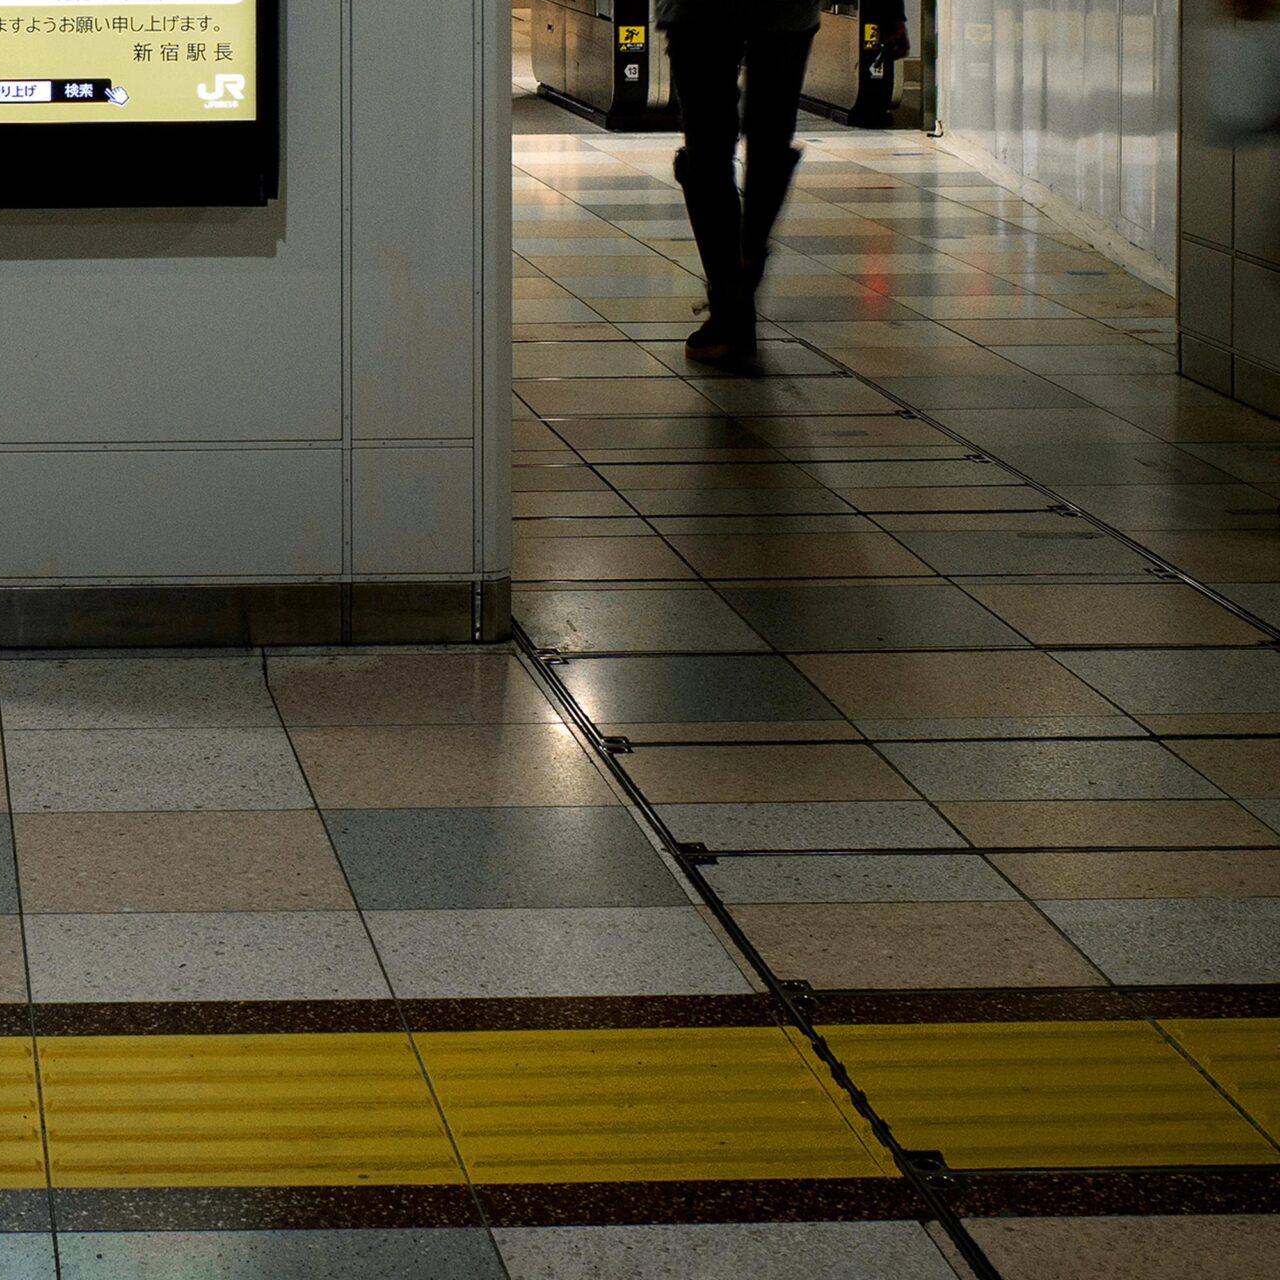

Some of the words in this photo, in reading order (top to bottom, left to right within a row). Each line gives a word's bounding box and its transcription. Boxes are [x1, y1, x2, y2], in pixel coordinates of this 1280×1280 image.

[134, 43, 232, 61] 新宿駅長
[64, 83, 94, 98] 検索
[197, 73, 246, 100] JR
